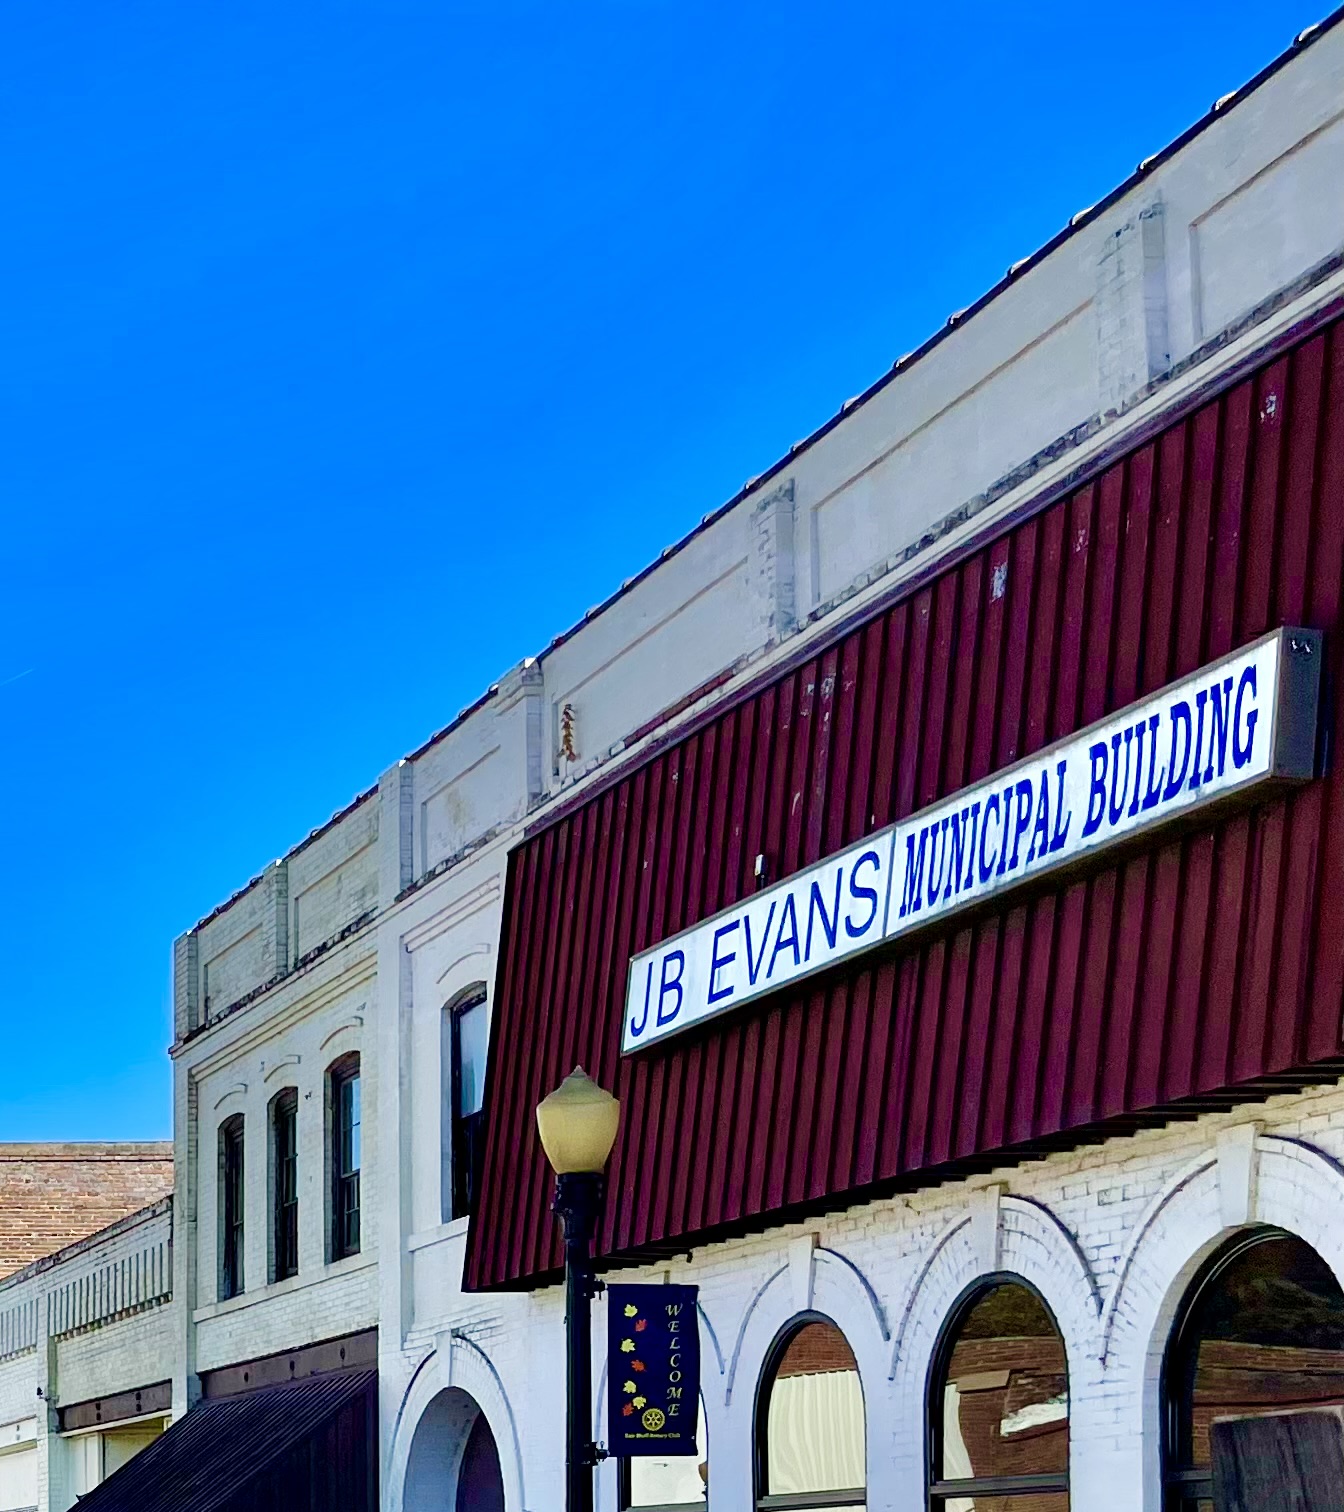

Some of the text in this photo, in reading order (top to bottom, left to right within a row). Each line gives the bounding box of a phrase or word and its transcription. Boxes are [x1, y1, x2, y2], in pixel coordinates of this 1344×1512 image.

[630, 662, 1260, 1038] JB EVANS MUNICIPAL BUILDING
[665, 1302, 684, 1417] WELCOME
